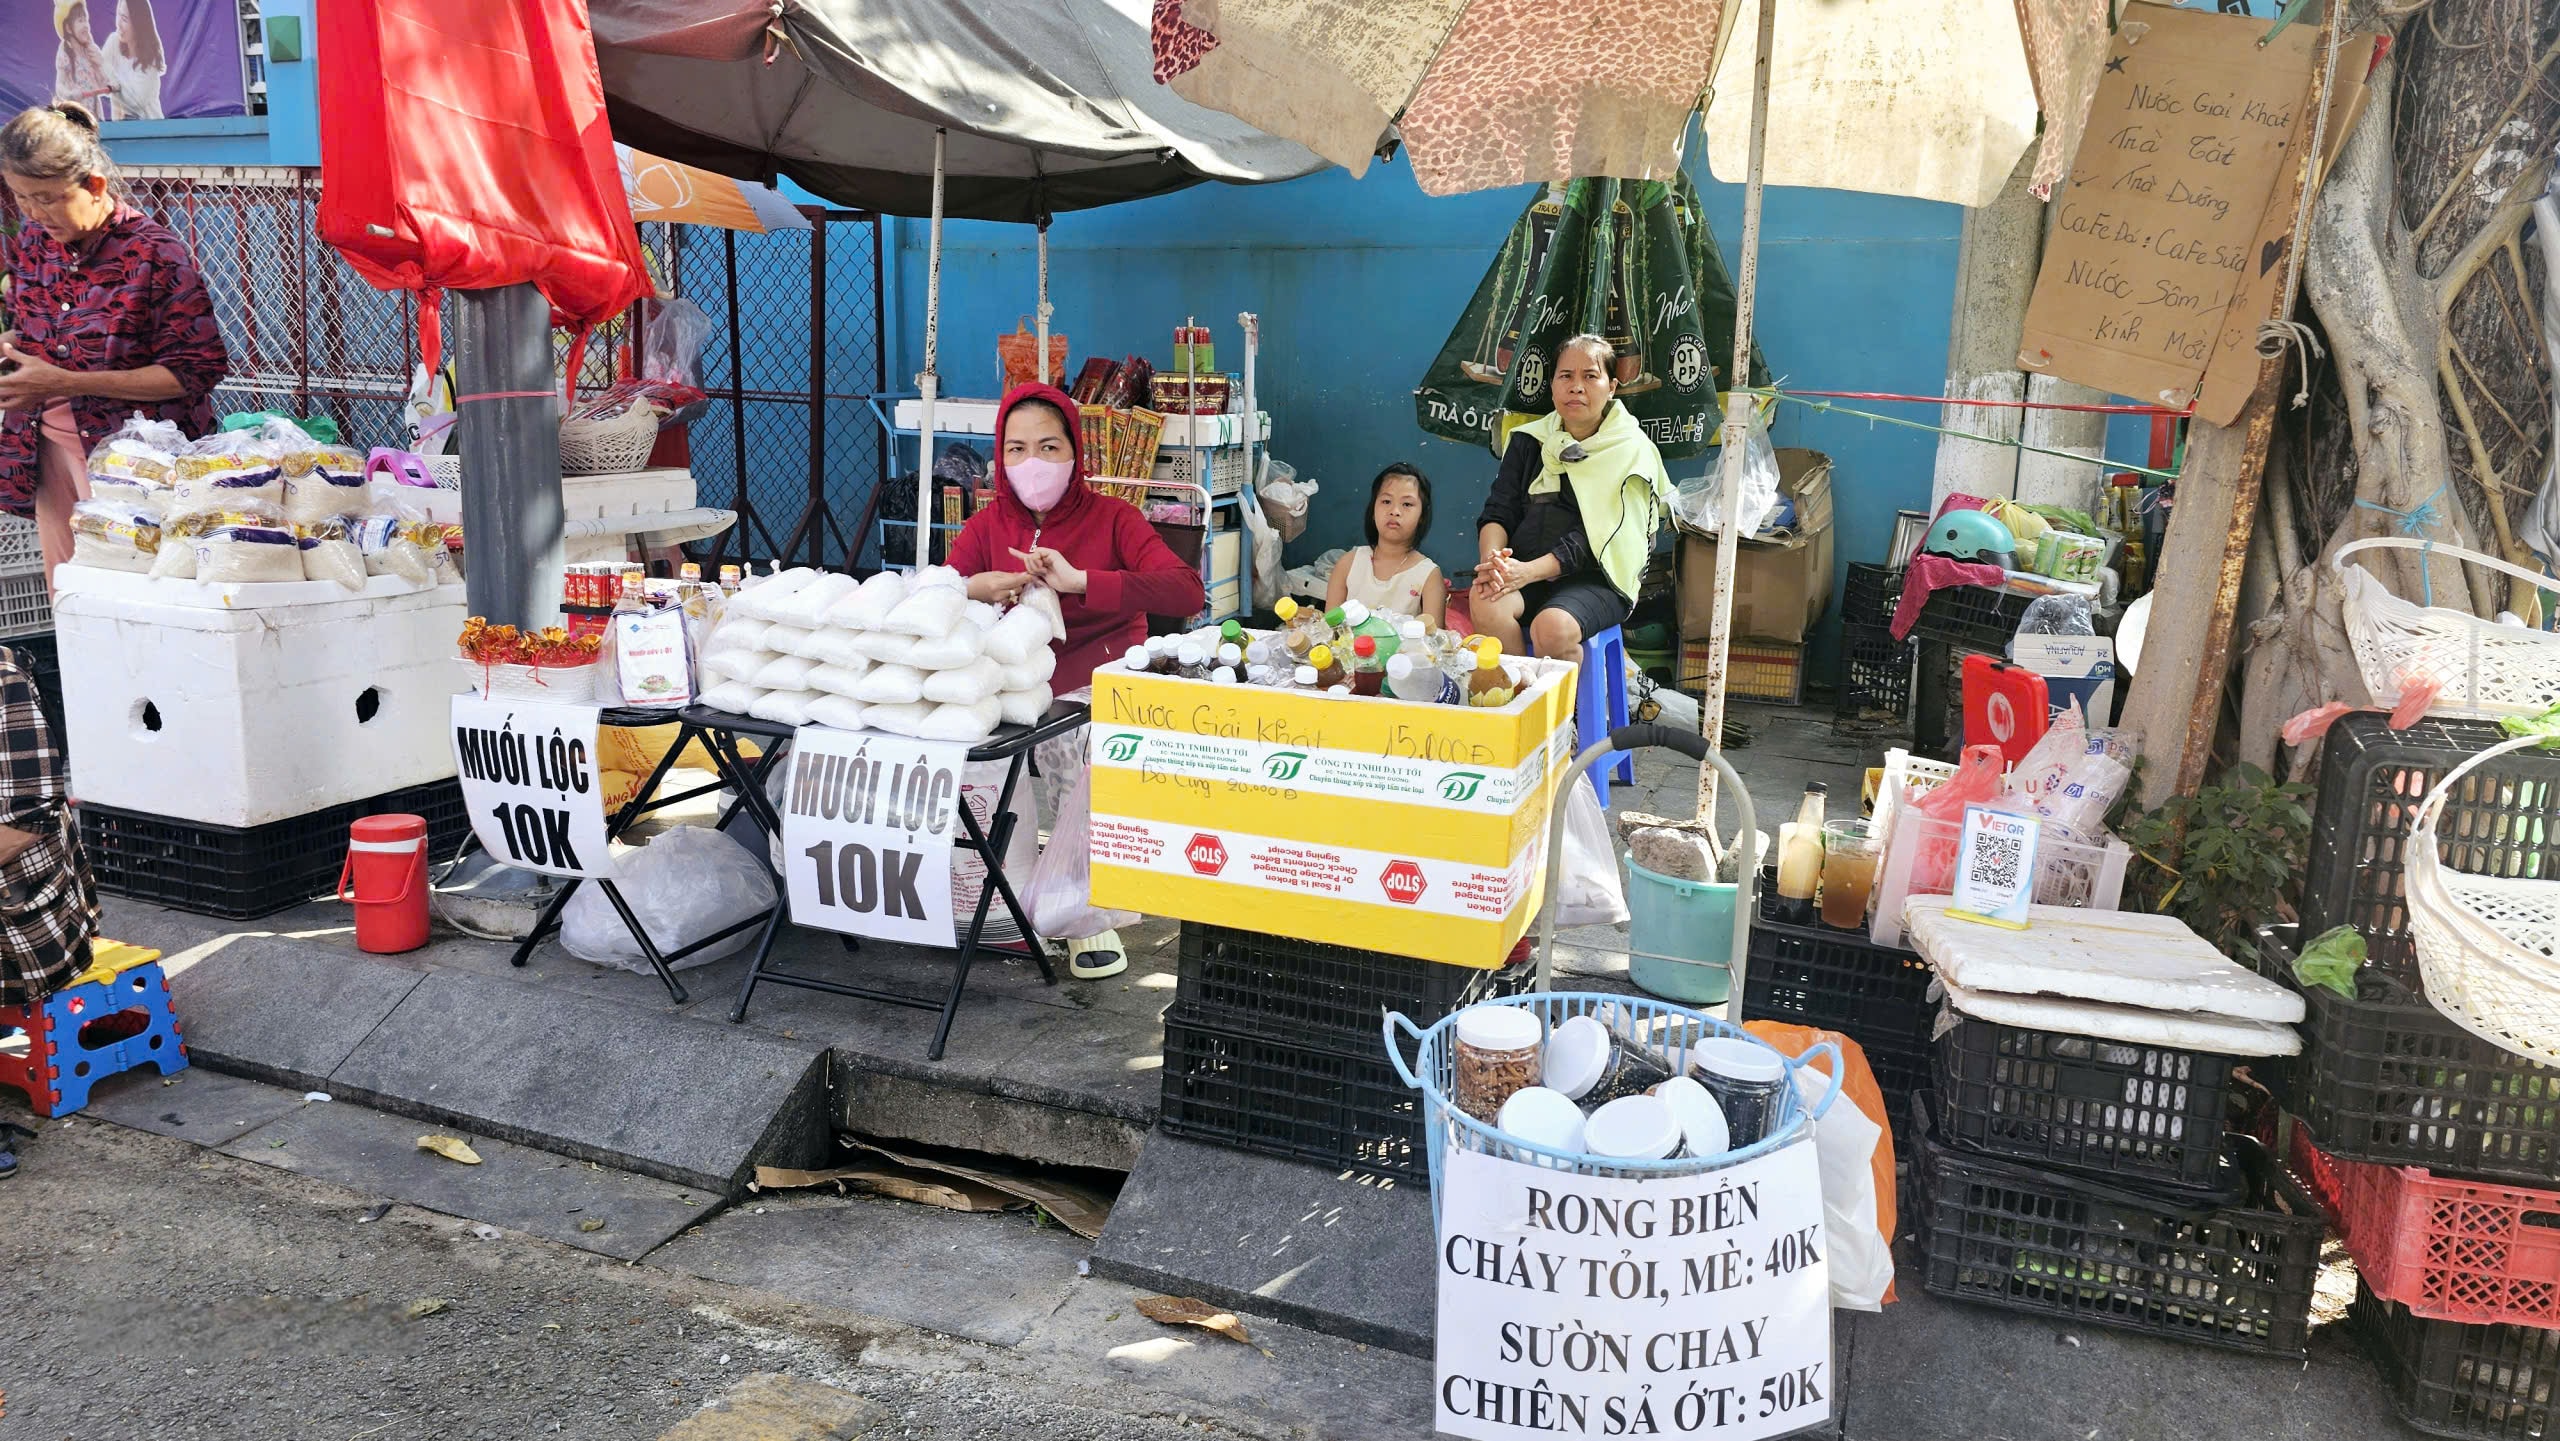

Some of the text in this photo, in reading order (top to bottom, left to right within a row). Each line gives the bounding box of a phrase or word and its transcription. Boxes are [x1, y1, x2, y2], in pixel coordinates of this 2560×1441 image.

[2240, 99, 2291, 128] Khát
[2108, 126, 2162, 153] Trà
[2112, 163, 2157, 193] Trà
[1428, 400, 1459, 425] TRÀ
[1462, 407, 1478, 429] Ô
[1150, 739, 1173, 749] CÔNG
[1176, 742, 1185, 750] TY
[457, 712, 531, 787] MUỐI
[535, 726, 589, 803] LỘC
[1314, 757, 1340, 768] CÔNG
[1343, 760, 1354, 769] TY
[1358, 762, 1381, 773] TNHH
[791, 736, 954, 844] MUỐI LỘC
[1494, 778, 1514, 787] CÔN
[1090, 820, 1115, 831] Recei
[1117, 823, 1150, 836] Signing
[1979, 813, 2025, 836] VIETQR
[492, 801, 583, 871] 10K
[1096, 831, 1135, 843] Contents
[1137, 837, 1165, 848] Check
[1090, 849, 1111, 858] Brok
[1111, 842, 1149, 855] Package
[1113, 852, 1121, 860] Is
[1123, 854, 1142, 863] Seal
[1152, 848, 1162, 856] Or
[1191, 844, 1222, 864] STOP
[1268, 846, 1341, 863] Signing Receipt
[1250, 853, 1358, 875] Check Contents Before
[1253, 863, 1354, 884] Or Package Damaged
[805, 840, 927, 921] 10K
[1265, 873, 1341, 893] If Seal Is Broken
[1386, 871, 1421, 893] STOP
[1451, 881, 1485, 892] Before
[1471, 873, 1508, 884] Receipt
[1454, 892, 1502, 905] Damaged
[1467, 903, 1502, 915] Broken
[1525, 1176, 1760, 1240] RONG BIỂN
[1445, 1223, 1822, 1307] CHÁY TỎI, MÈ: 40K
[1500, 1315, 1769, 1374] SƯỜN CHAY
[1442, 1361, 1825, 1436] CHIÊN SẢ ỚT: 50K
